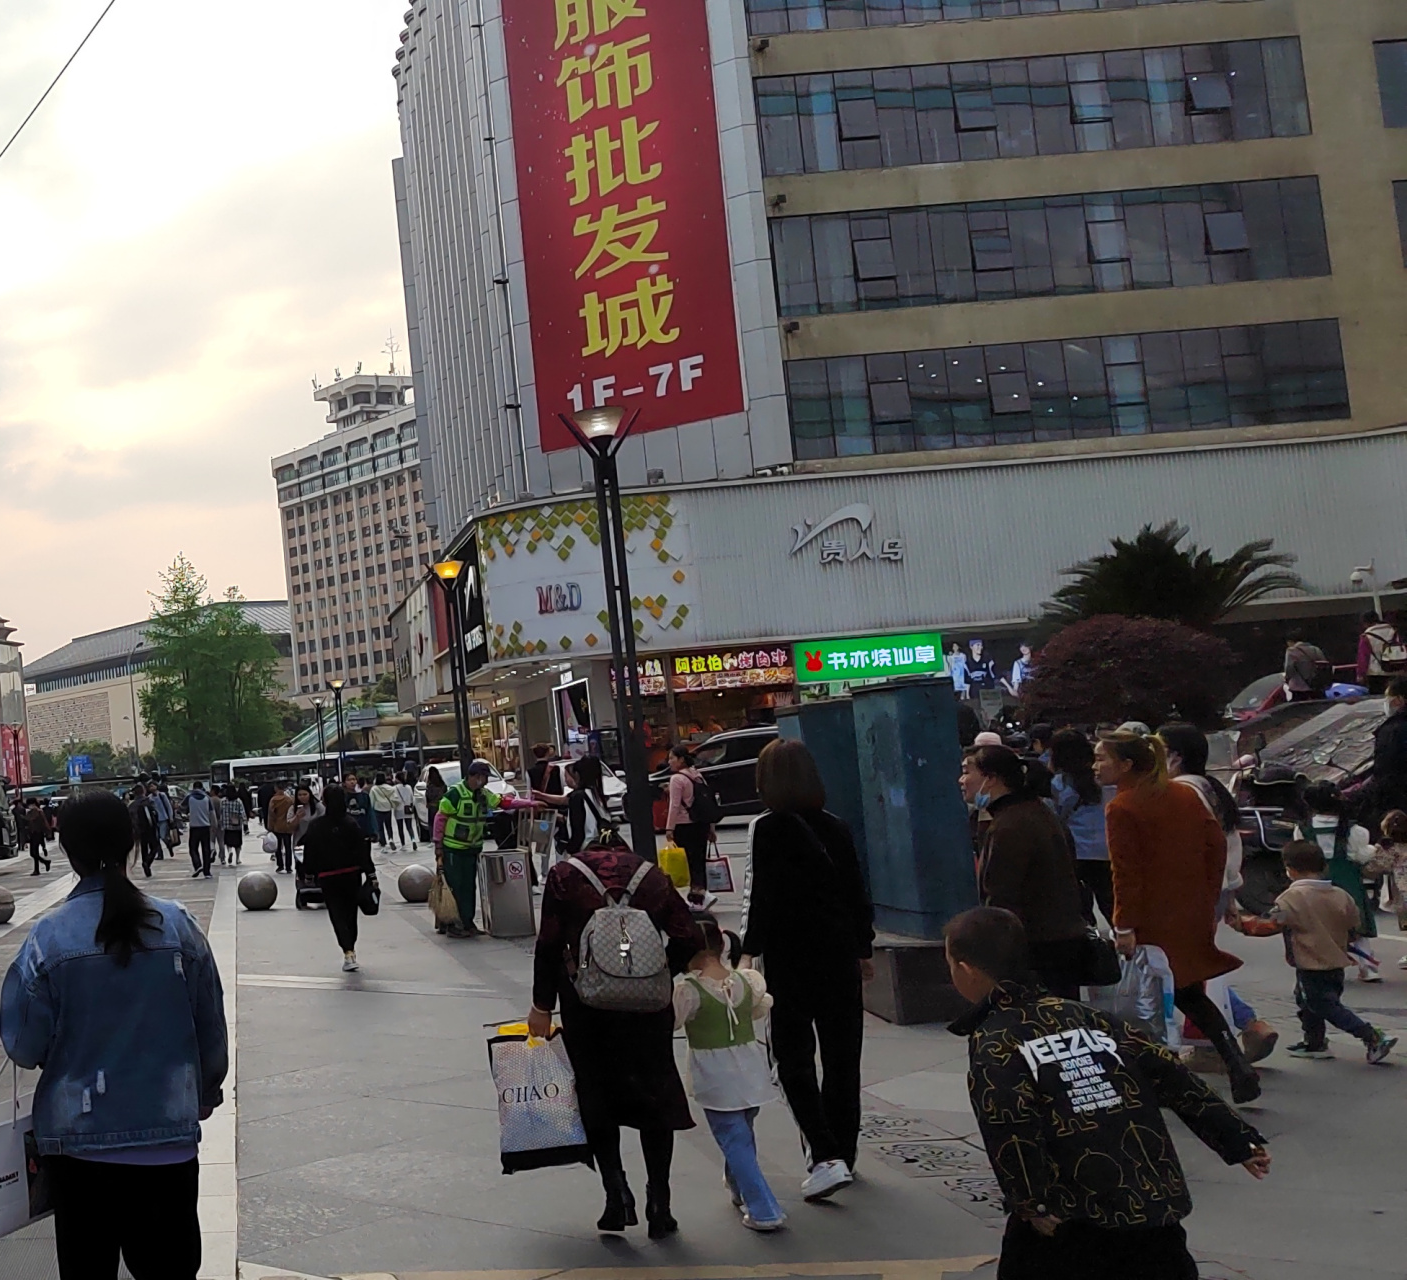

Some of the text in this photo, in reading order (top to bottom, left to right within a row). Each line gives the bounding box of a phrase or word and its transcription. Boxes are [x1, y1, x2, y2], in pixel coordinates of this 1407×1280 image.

[566, 354, 704, 413] 1F-7F
[819, 535, 905, 565] 贵人鸟
[536, 582, 583, 615] M&D
[675, 653, 723, 674] 阿拉伯
[826, 644, 937, 671] 书亦烧仙草
[1016, 1028, 1126, 1084] YEEZUS
[501, 1082, 560, 1105] CHAO
